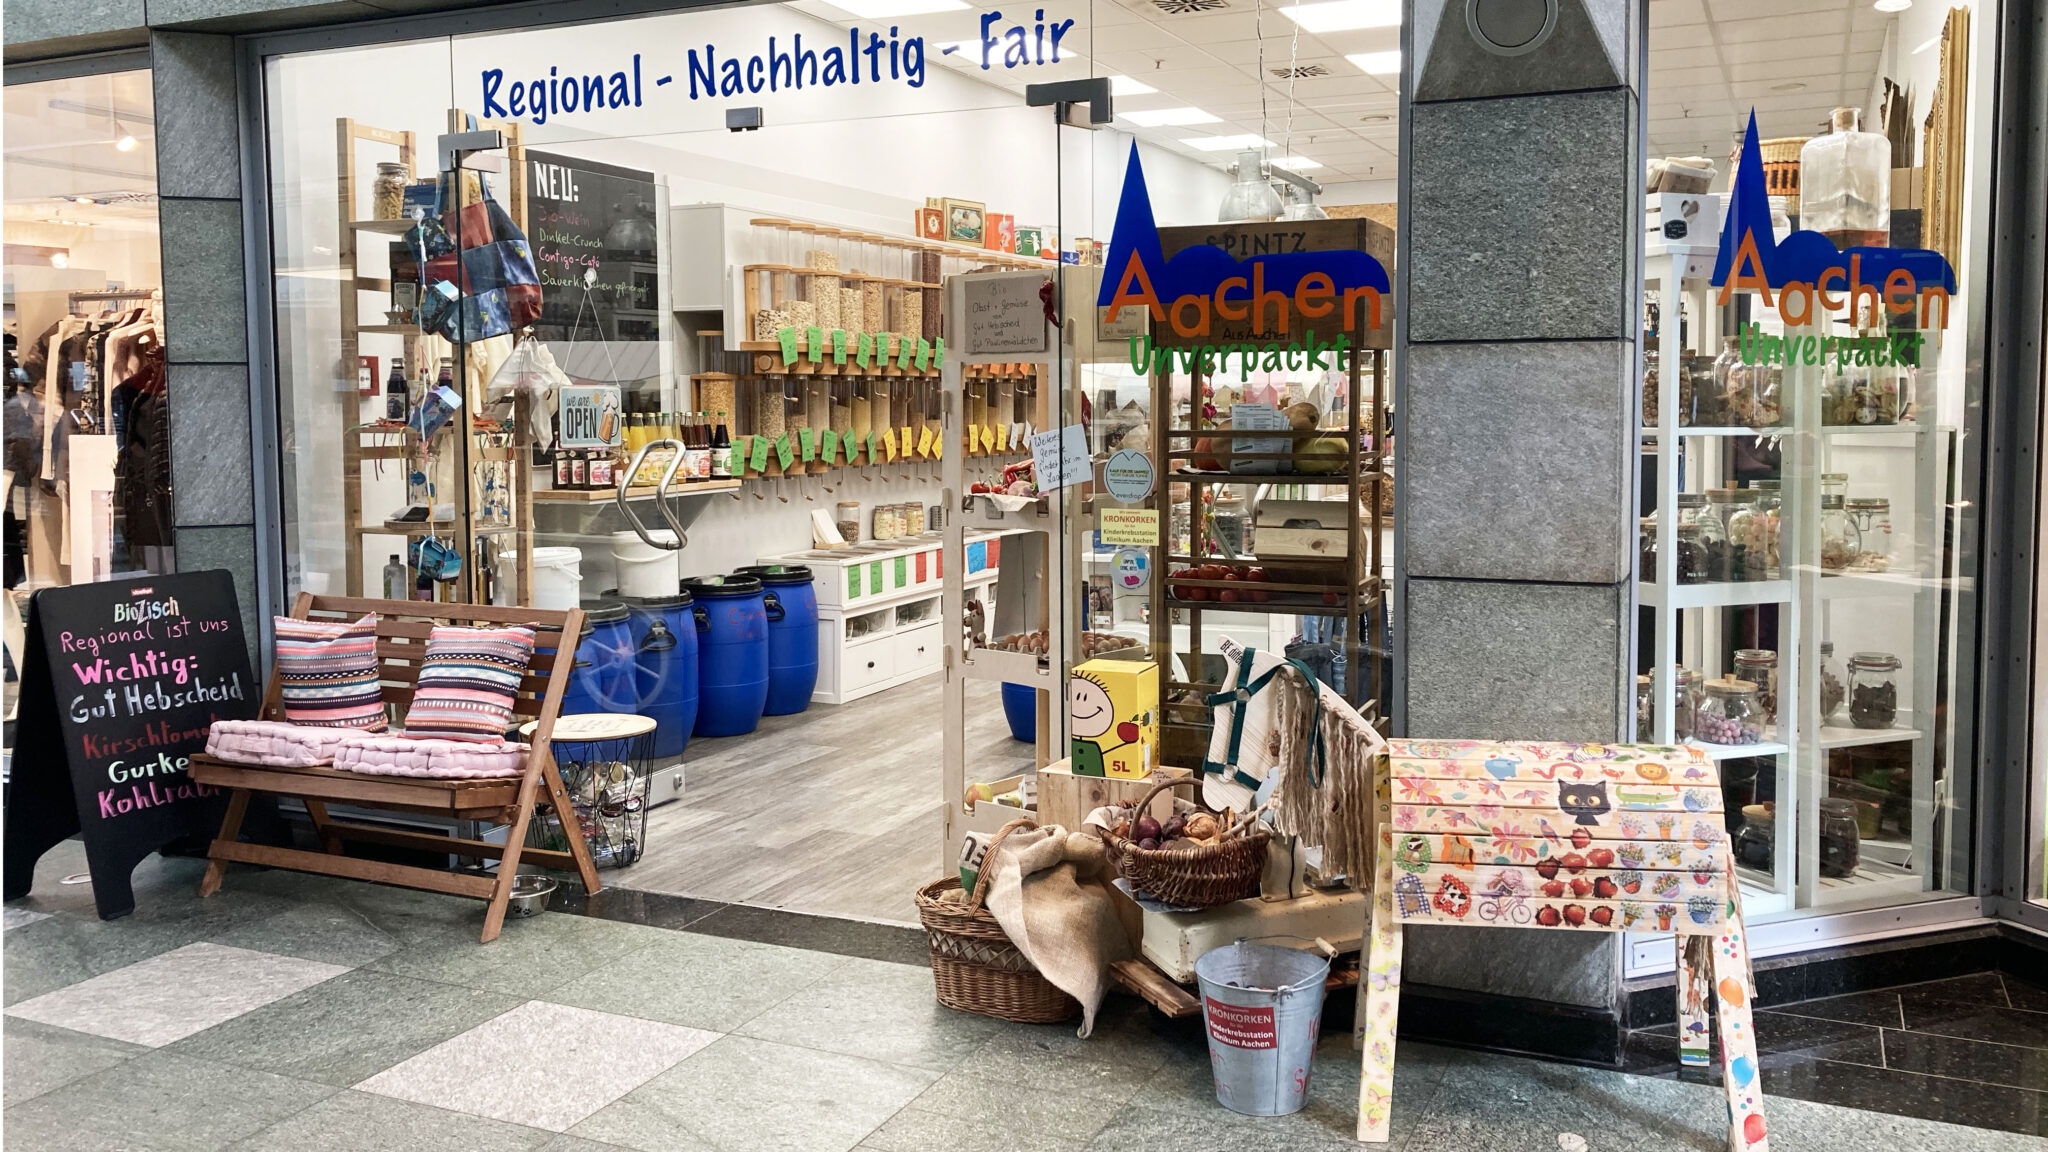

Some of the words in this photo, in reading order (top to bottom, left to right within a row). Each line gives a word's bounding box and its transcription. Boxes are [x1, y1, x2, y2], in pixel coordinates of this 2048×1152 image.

[482, 54, 642, 125] Regional
[688, 26, 925, 100] Nachhaltig
[981, 9, 1074, 70] Fair
[534, 161, 579, 202] NEU:
[1104, 247, 1381, 338] Aachen
[1716, 225, 1949, 329] Aachen
[1129, 329, 1351, 382] Unverpackt
[1740, 321, 1926, 376] Unverpackt
[566, 407, 597, 440] OPEN
[1103, 515, 1157, 523] KRONKORKEN
[114, 596, 180, 625] BioZisch
[60, 621, 155, 657] Regional
[166, 615, 191, 639] ist
[200, 619, 229, 633] uns
[1220, 639, 1234, 654] BE
[72, 649, 199, 685] Wichtig:
[70, 688, 117, 724] Gut
[123, 671, 244, 716] Hebscheid
[1112, 760, 1131, 773] 5L
[1208, 1004, 1271, 1024] KRONKORKEN
[1210, 1020, 1274, 1039] Kinderkrebsstation
[1213, 1031, 1240, 1045] Klinikum
[1242, 1039, 1270, 1048] Aachen
